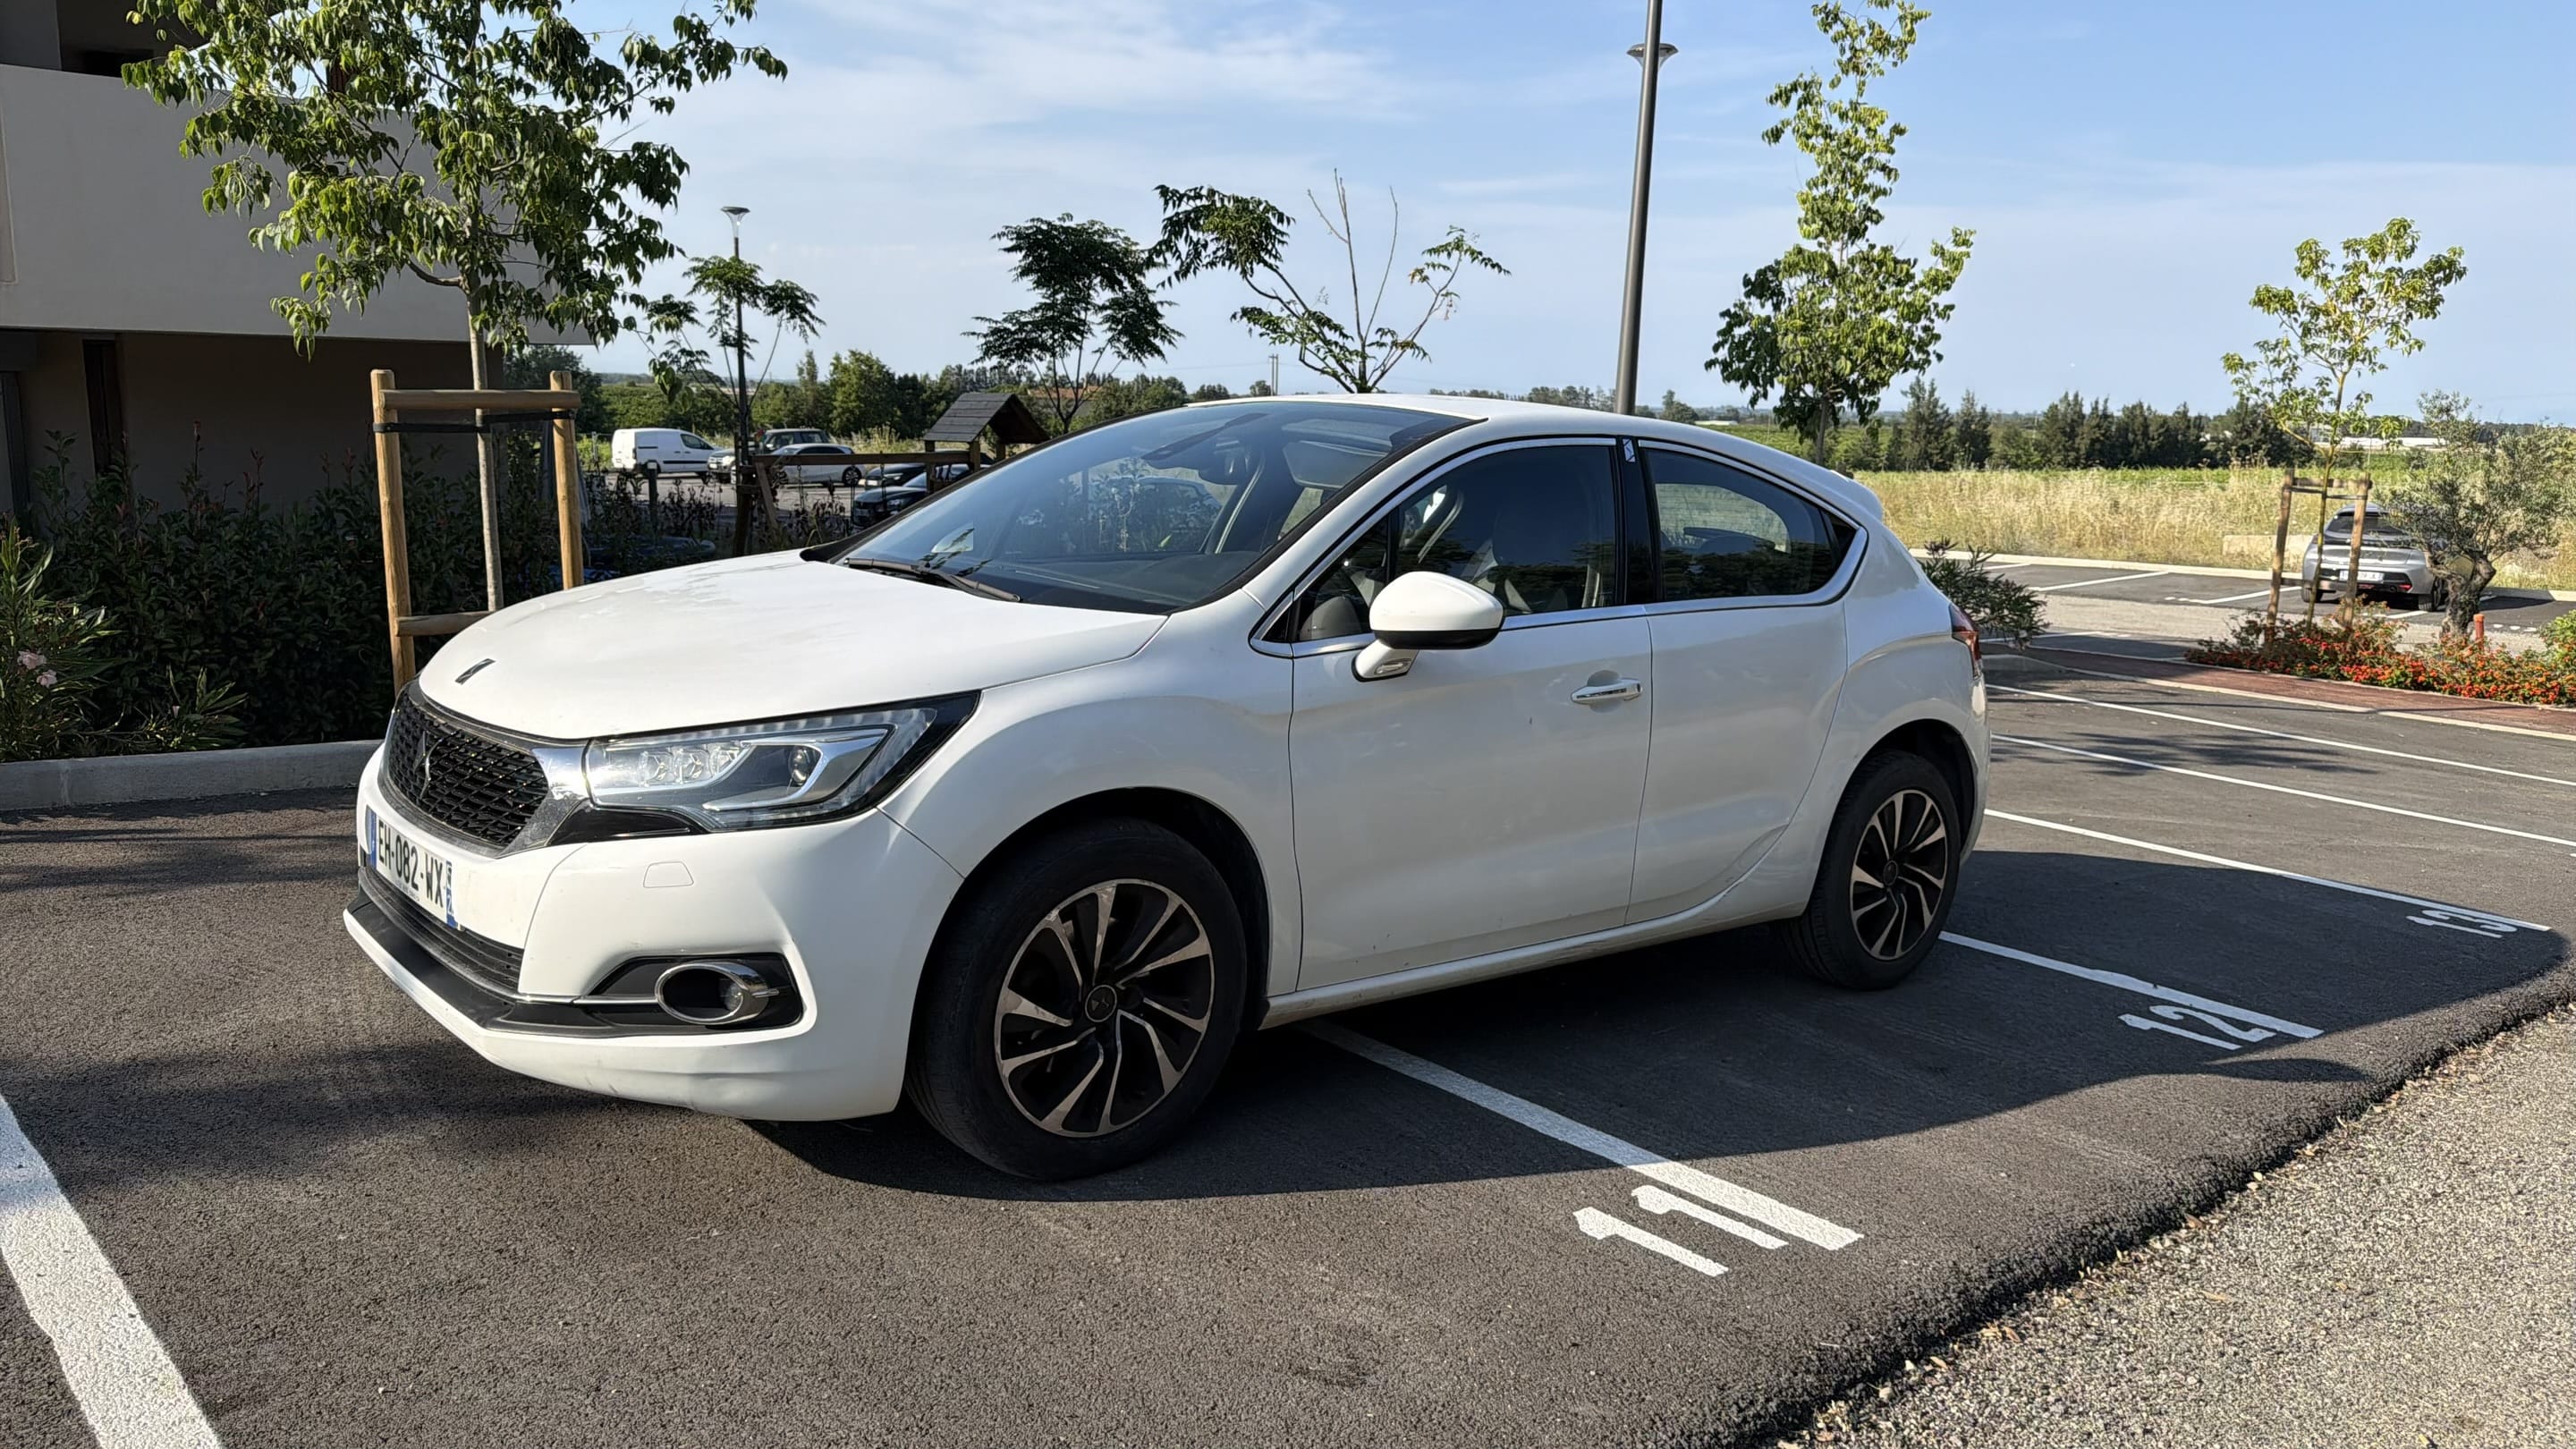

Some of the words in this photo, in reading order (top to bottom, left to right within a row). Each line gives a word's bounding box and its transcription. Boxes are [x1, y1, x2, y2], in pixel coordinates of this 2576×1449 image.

[378, 818, 444, 908] EH-082-WX
[2405, 910, 2518, 938] 13
[2117, 1004, 2277, 1051] 12
[1572, 1184, 1790, 1277] 11
